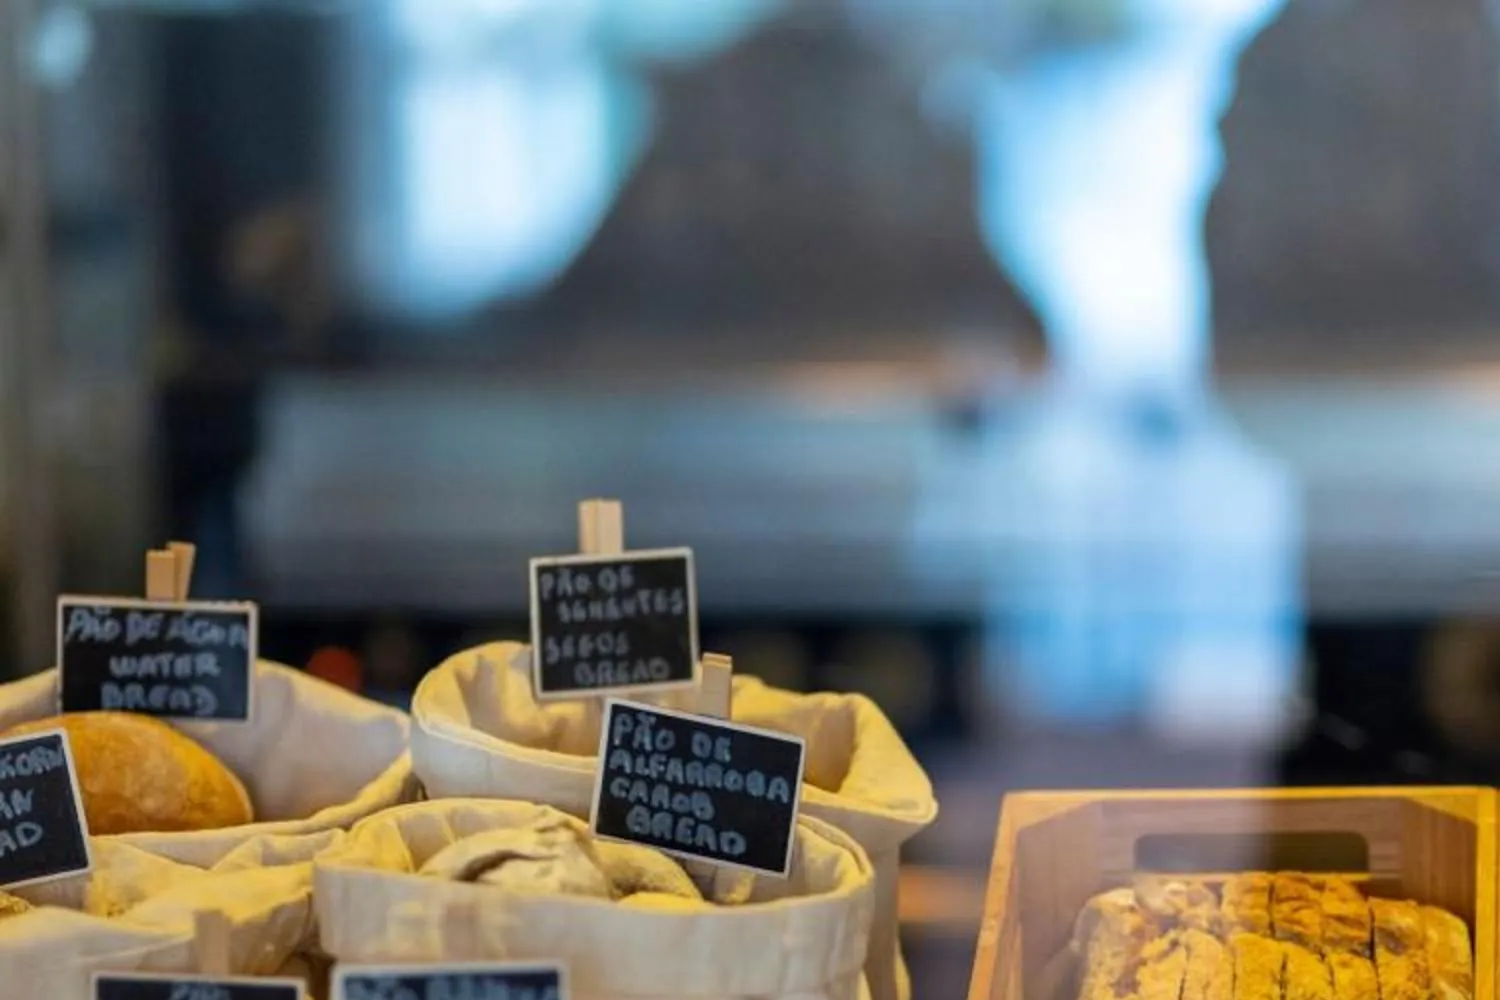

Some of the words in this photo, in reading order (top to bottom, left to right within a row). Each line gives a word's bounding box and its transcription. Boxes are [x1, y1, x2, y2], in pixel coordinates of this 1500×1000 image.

[541, 567, 591, 600] PÃO
[109, 652, 221, 679] WATER
[101, 682, 218, 717] BREAD
[613, 711, 676, 751] PÃO
[609, 748, 790, 804] ALFARROBA
[609, 776, 716, 821] CAROB
